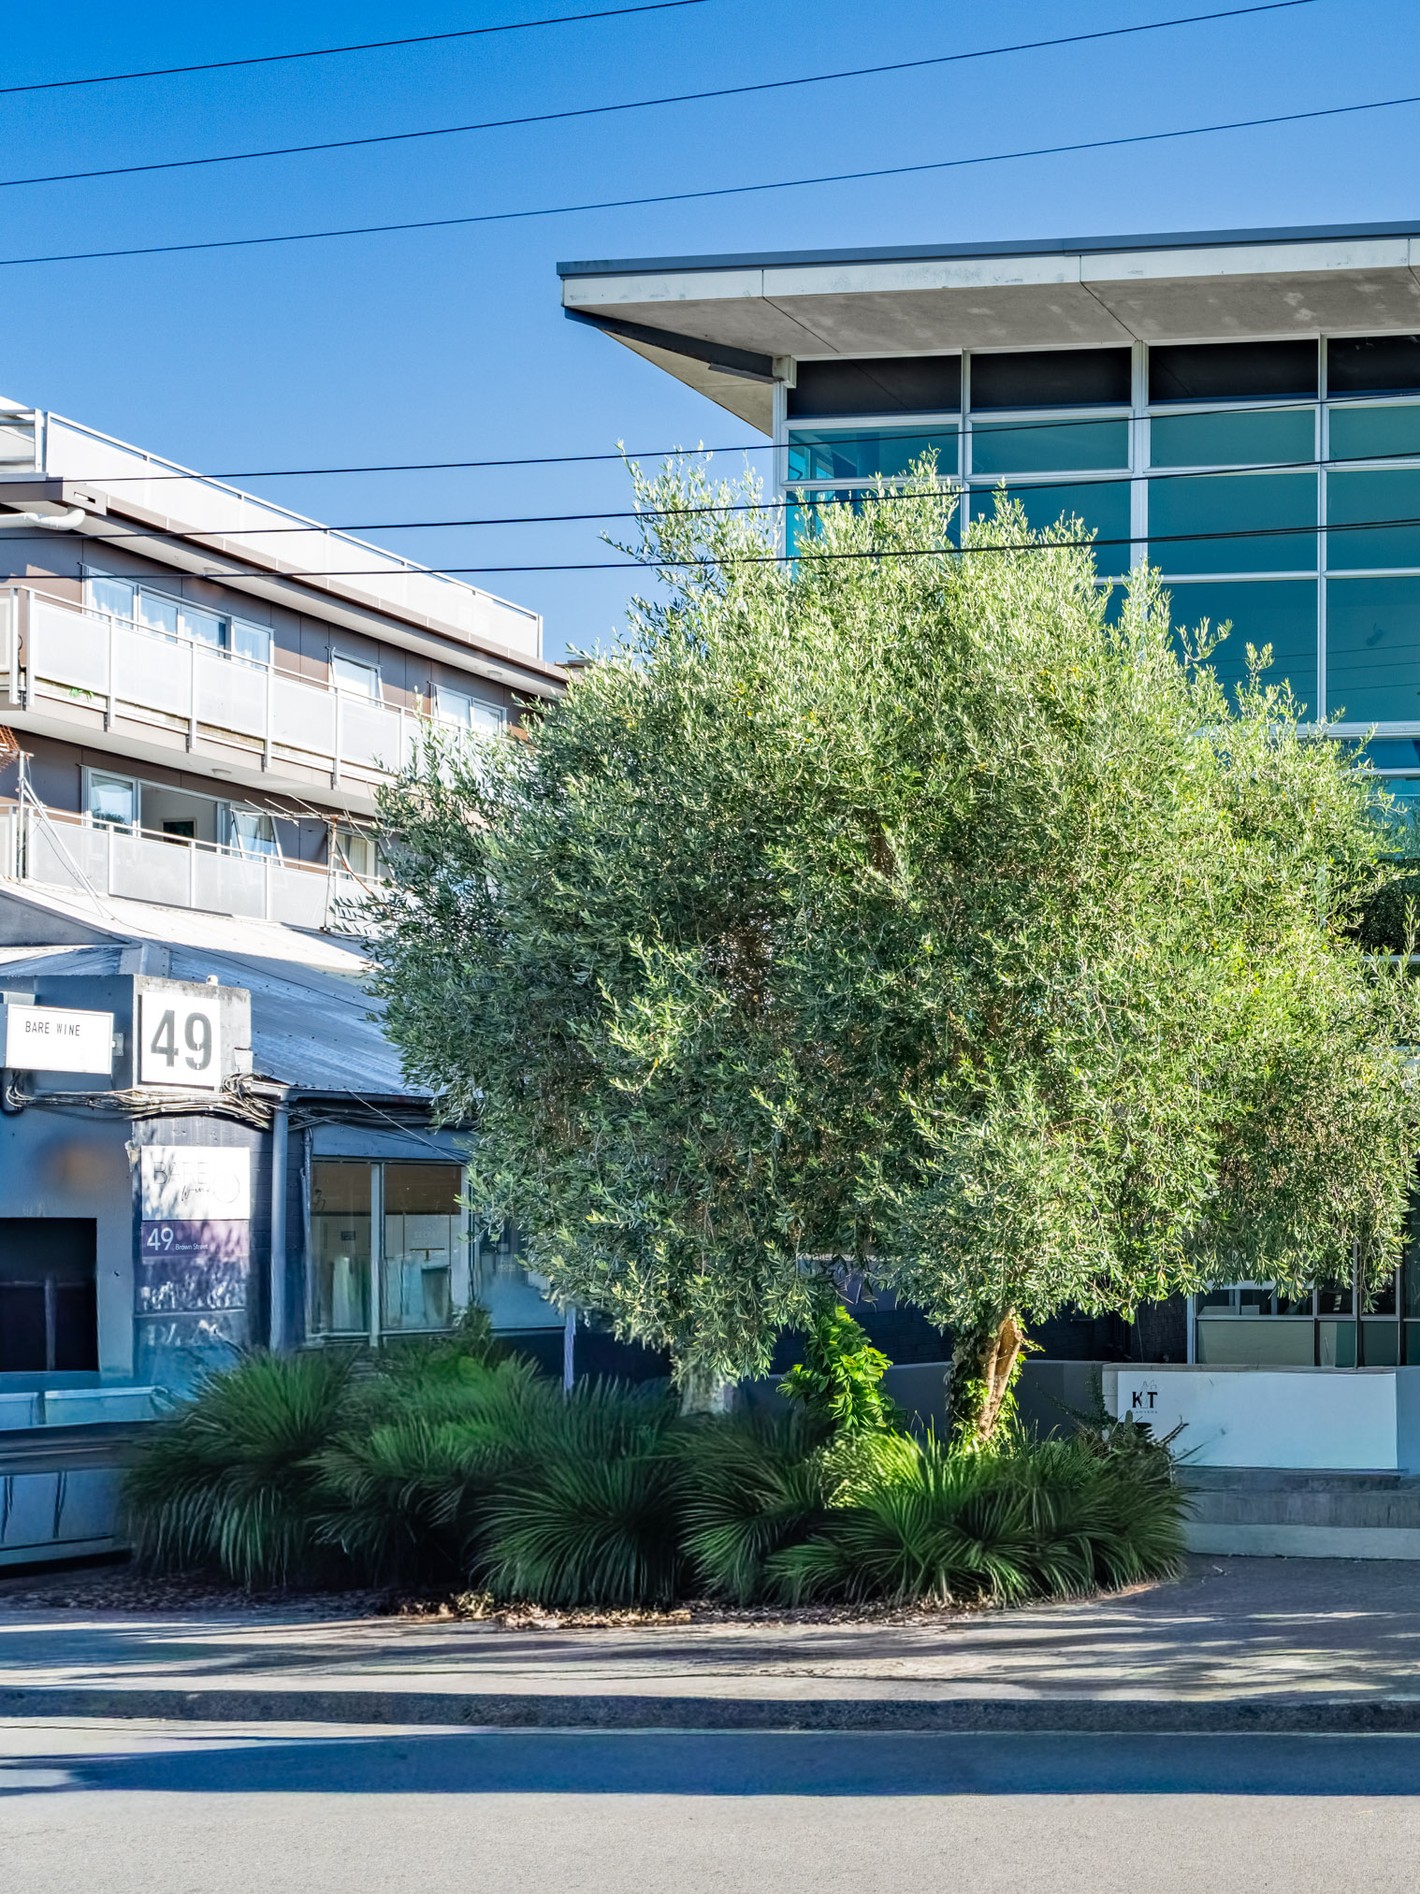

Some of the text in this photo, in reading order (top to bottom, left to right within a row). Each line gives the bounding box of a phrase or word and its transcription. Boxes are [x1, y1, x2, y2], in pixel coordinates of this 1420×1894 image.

[25, 1020, 81, 1037] BARE WINE
[150, 1009, 213, 1071] 49
[146, 1227, 174, 1251] 49
[193, 1243, 209, 1251] Street
